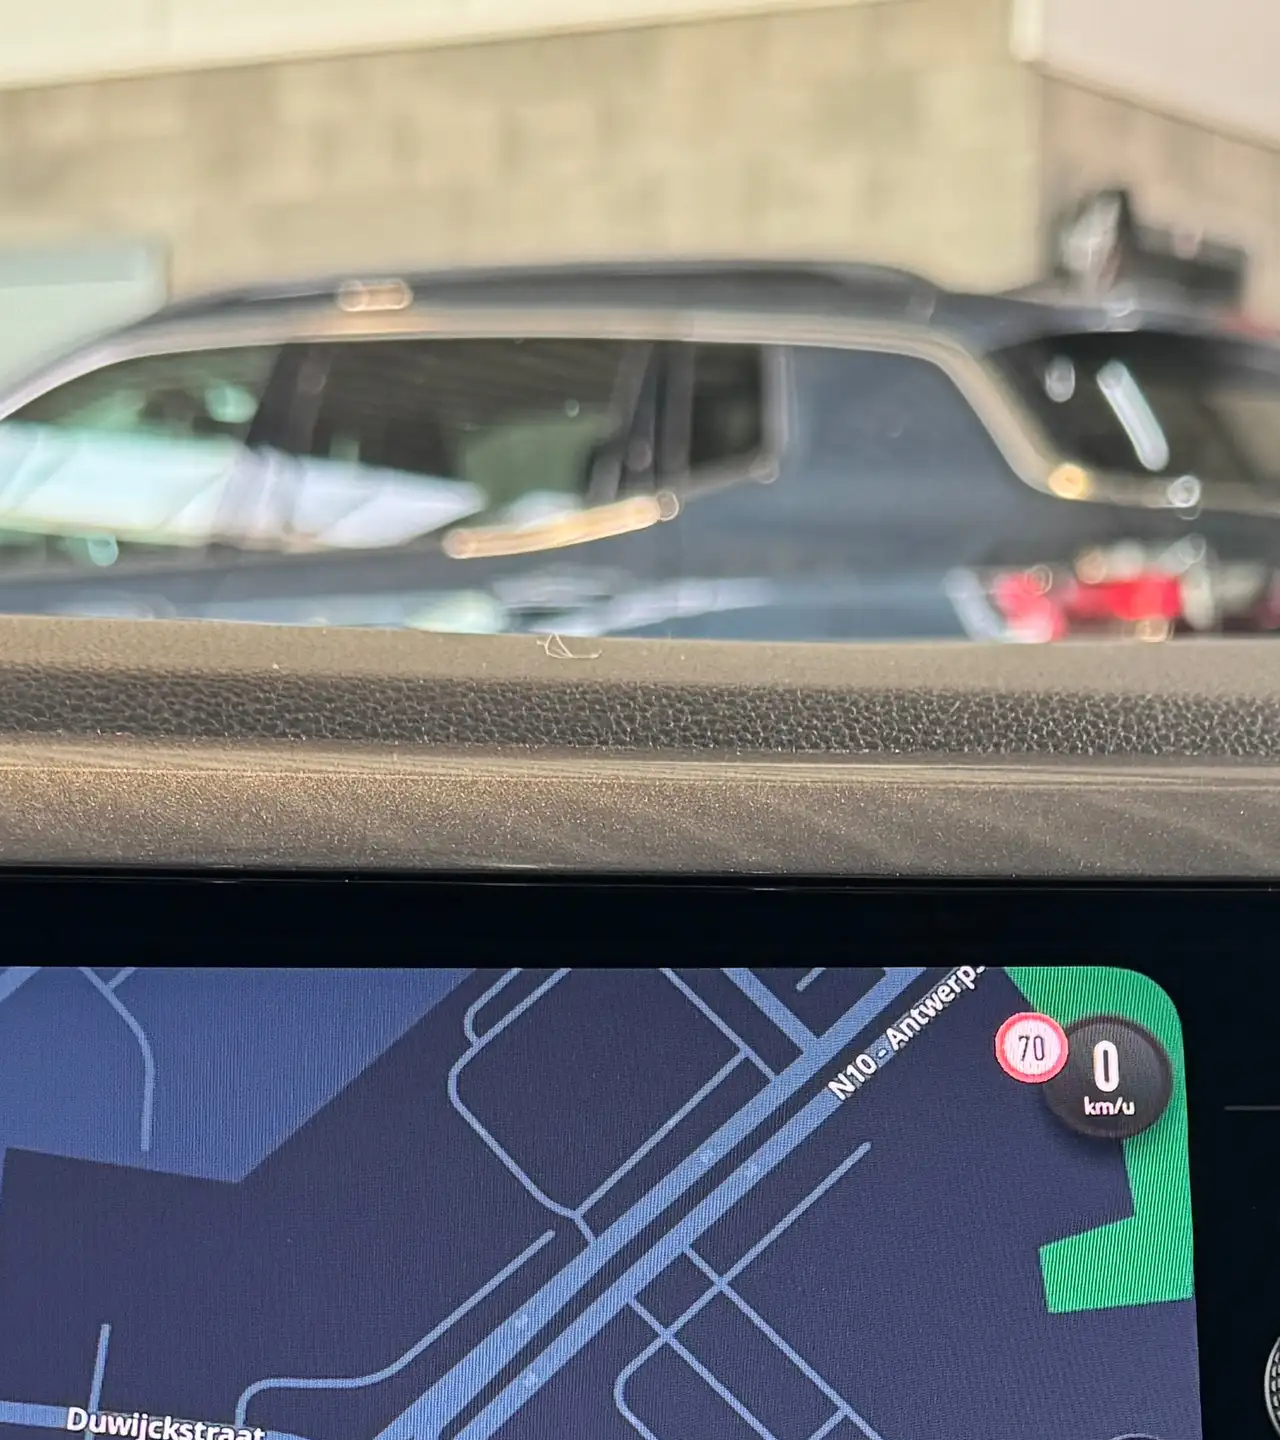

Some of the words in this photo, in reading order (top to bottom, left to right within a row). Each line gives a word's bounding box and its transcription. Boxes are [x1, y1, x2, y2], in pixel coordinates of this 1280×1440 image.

[1018, 1035, 1044, 1062] 70
[1092, 1039, 1120, 1093] 0
[827, 1053, 877, 1101] N10
[1083, 1096, 1135, 1116] km/u
